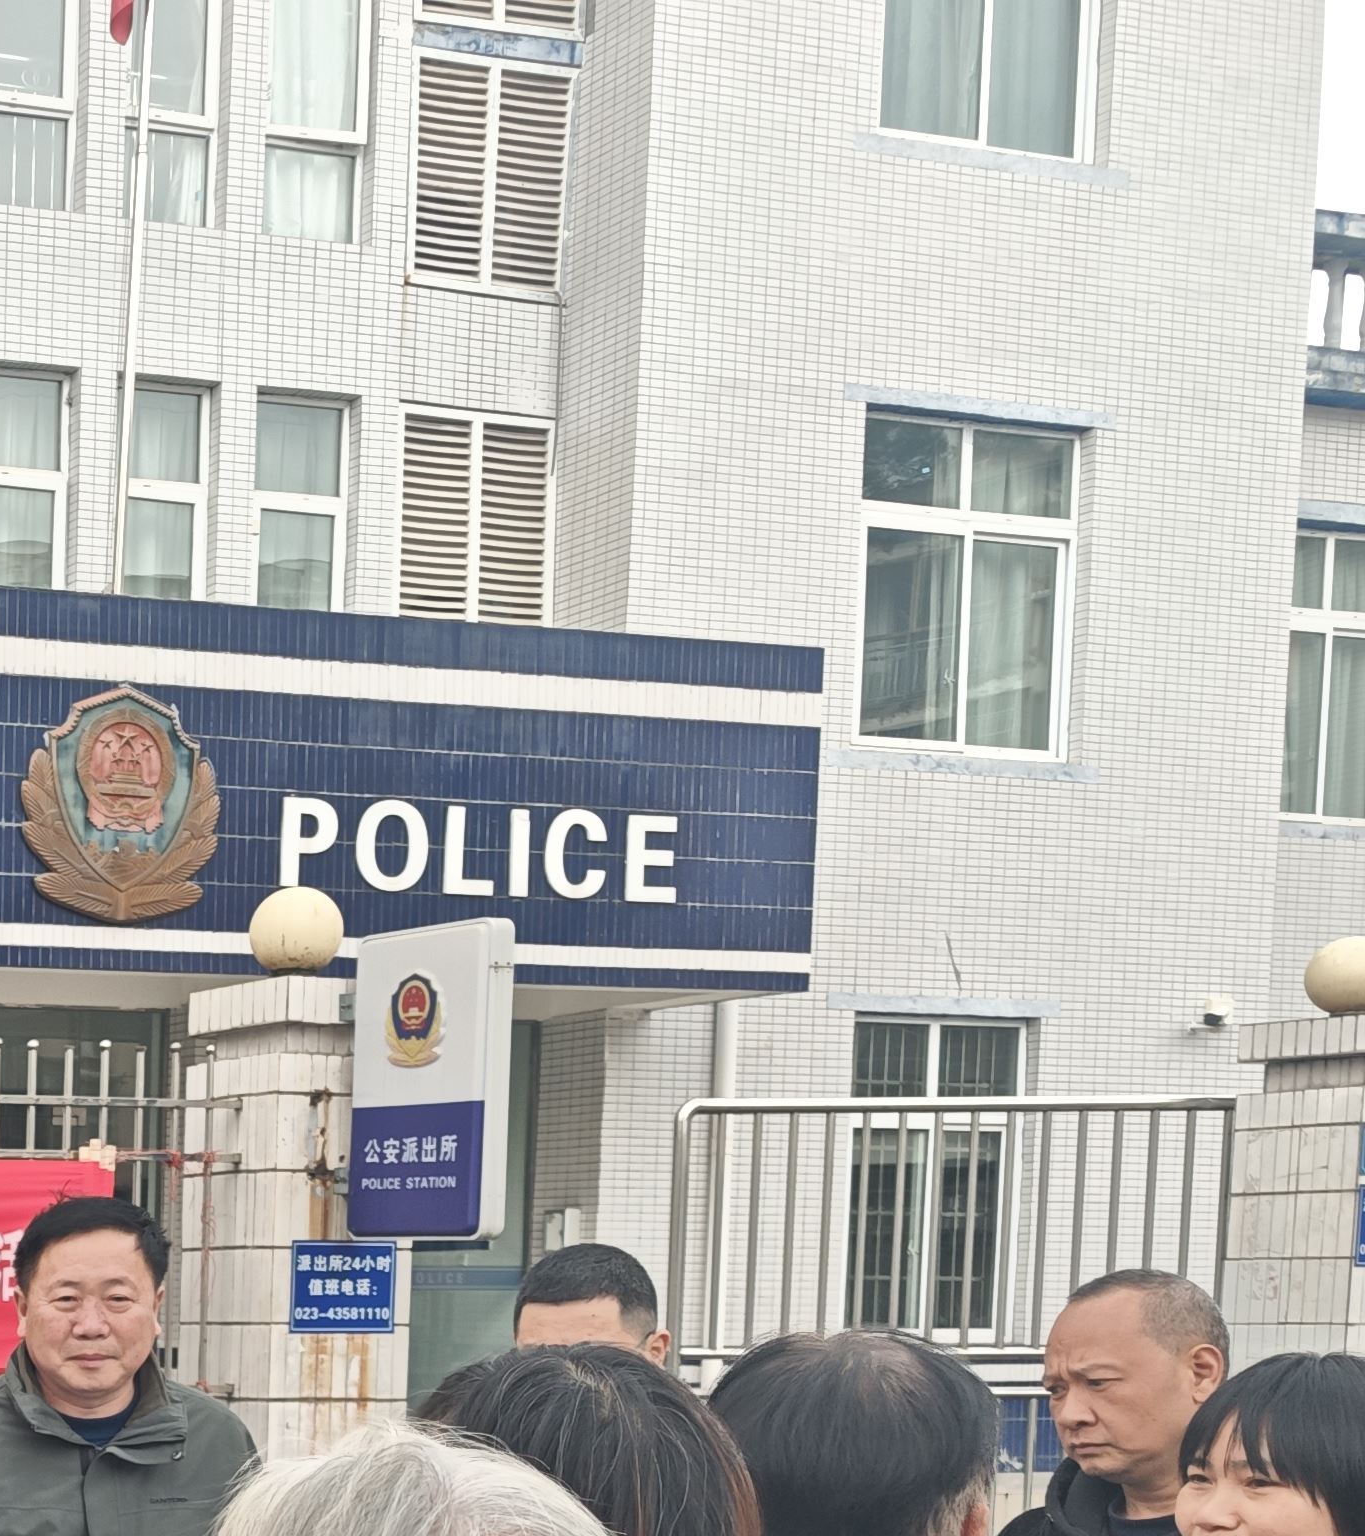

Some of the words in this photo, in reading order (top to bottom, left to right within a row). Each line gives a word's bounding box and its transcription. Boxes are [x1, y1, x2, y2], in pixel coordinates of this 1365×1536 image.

[279, 796, 679, 904] POLICE
[364, 1134, 458, 1164] 公安派出所
[361, 1177, 401, 1190] POLICE
[405, 1175, 457, 1189] STATION
[297, 1254, 391, 1272] 派出所24小时
[416, 1271, 464, 1285] OLICE
[294, 1306, 390, 1320] 023-43581110
